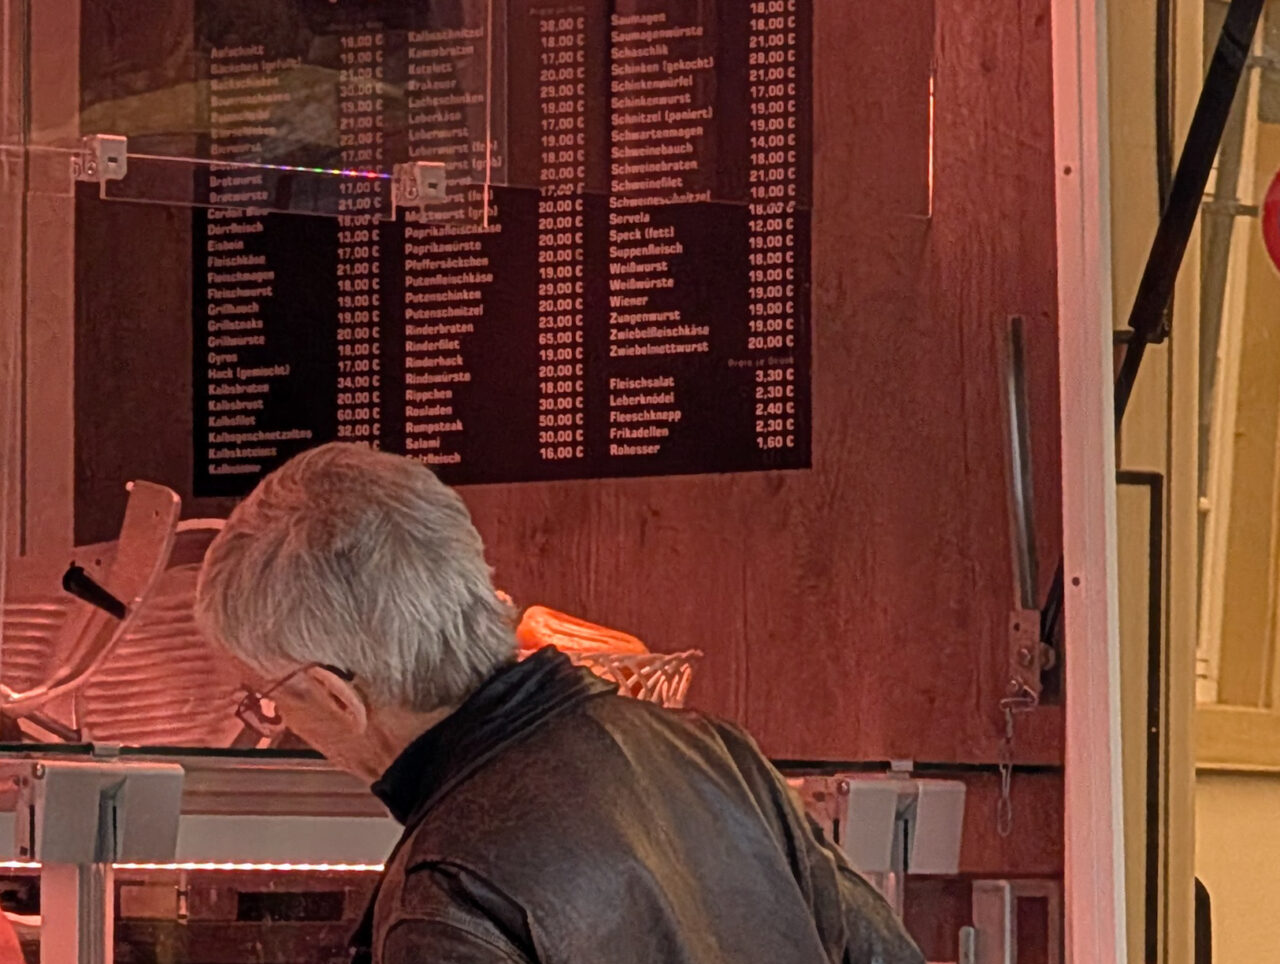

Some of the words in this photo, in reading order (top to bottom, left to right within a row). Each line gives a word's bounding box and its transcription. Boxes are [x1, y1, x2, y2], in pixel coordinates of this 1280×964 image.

[749, 0, 785, 15] 18,00
[749, 16, 785, 31] 18,00
[749, 33, 785, 49] 21,00
[610, 62, 660, 76] Schinken
[748, 50, 785, 65] 28,00
[610, 75, 694, 93] Schinkenwürfel
[749, 66, 785, 82] 21,00
[610, 92, 692, 109] Schinkenwurst
[749, 83, 785, 99] 17,00
[610, 110, 662, 126] Schnitzel
[750, 100, 785, 115] 19,00
[610, 125, 704, 143] Schwartenmagen
[750, 117, 785, 132] 19,00
[610, 142, 694, 159] Schweinebauch
[750, 134, 785, 149] 14,00
[610, 159, 698, 176] Schweinebraten
[750, 150, 785, 166] 18,00
[610, 176, 684, 193] Schweinefilet
[749, 167, 785, 183] 21,00
[749, 184, 785, 199] 18,00
[468, 205, 499, 223] (grb)
[608, 211, 651, 226] Servela
[609, 227, 642, 244] Speck
[748, 218, 783, 233] 12,00
[404, 240, 482, 257] Paprikawürste
[609, 242, 684, 260] Suppenfleisch
[748, 234, 783, 249] 19,00
[609, 260, 668, 275] Weißwurst
[748, 251, 783, 266] 18,00
[748, 268, 783, 283] 19,00
[404, 288, 482, 304] Putenschinken
[609, 295, 649, 308] Wiener
[748, 284, 783, 300] 19,00
[609, 310, 681, 326] Zungenwurst
[748, 301, 783, 316] 19,00
[405, 322, 475, 336] Rinderbraten
[748, 318, 783, 333] 19,00
[405, 338, 461, 353] Rinderfilet
[538, 331, 573, 345] 65,00
[609, 341, 709, 358] Zwiebelmettwurst
[747, 335, 783, 350] 20,00
[207, 351, 238, 366] Gyros
[337, 342, 370, 357] 18,00
[405, 353, 464, 369] Rinderhack
[207, 367, 234, 380] Hack
[337, 375, 370, 389] 34,00
[609, 375, 675, 391] Fleischsalat
[755, 368, 783, 383] 3,30
[336, 391, 370, 406] 20,00
[405, 388, 453, 403] Rippchen
[609, 391, 675, 407] Leberknödel
[755, 385, 784, 400] 2,30
[336, 407, 370, 422] 60,00
[405, 404, 453, 417] Rouladen
[755, 402, 783, 416] 2,40
[405, 419, 464, 435] Rumpsteak
[538, 413, 573, 427] 50,00
[609, 425, 670, 440] Frikadellen
[755, 418, 783, 433] 2,30
[405, 436, 441, 450] Salami
[756, 435, 784, 450] 1,60
[539, 446, 573, 460] 16,00
